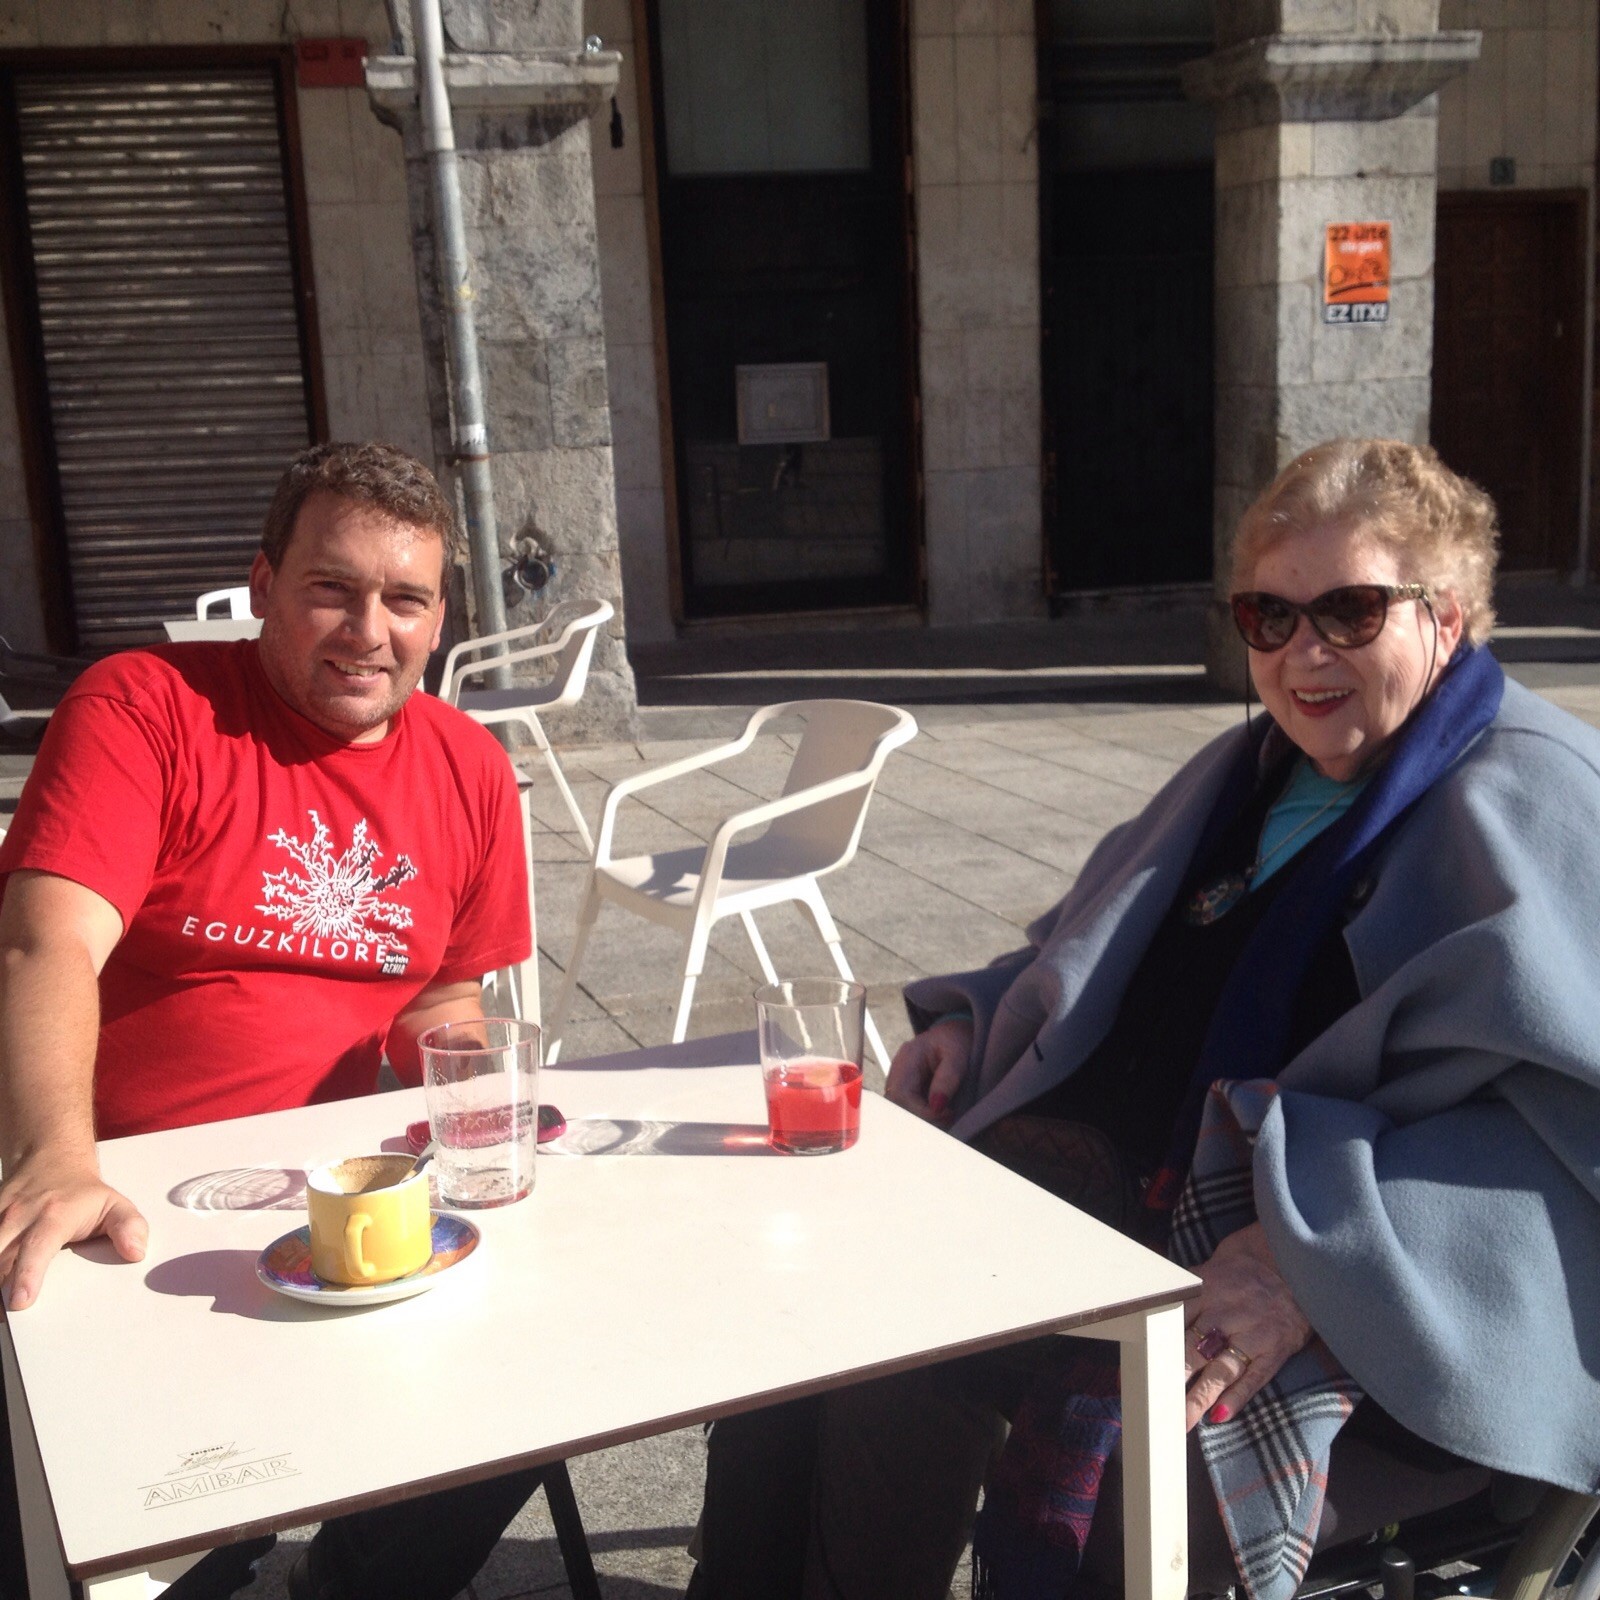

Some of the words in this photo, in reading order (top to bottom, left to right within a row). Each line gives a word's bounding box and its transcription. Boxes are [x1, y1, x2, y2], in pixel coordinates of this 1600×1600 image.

[1326, 304, 1350, 322] EZ
[181, 915, 388, 964] EGUZKILORE
[143, 1458, 298, 1507] AMBAR
